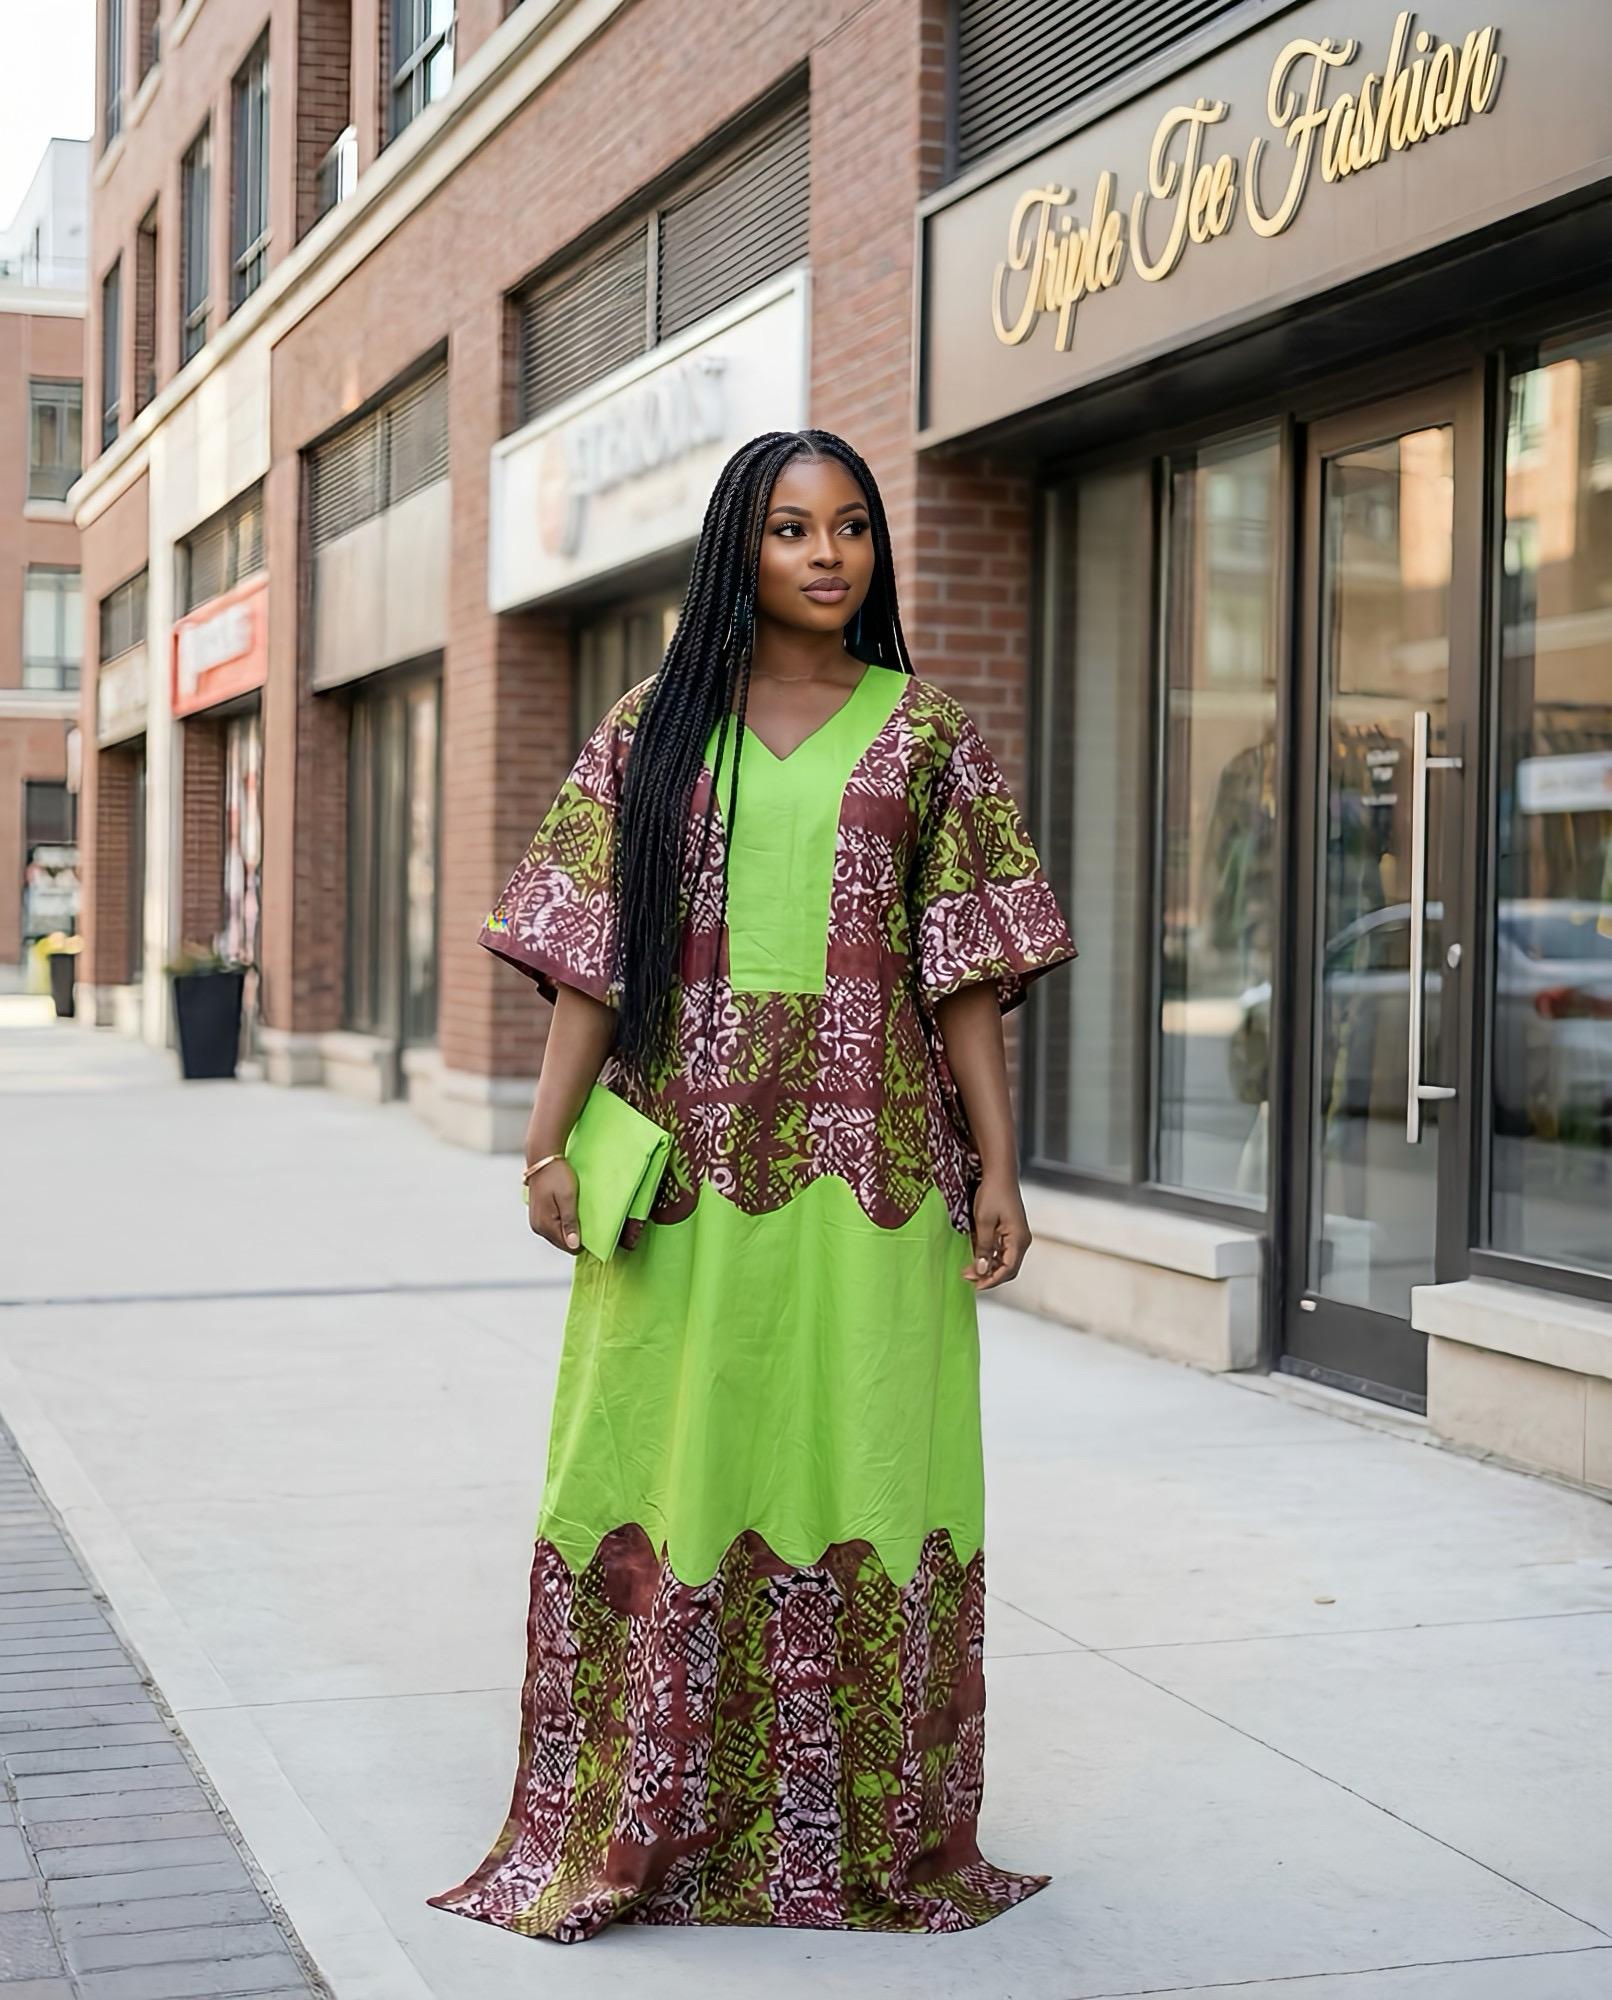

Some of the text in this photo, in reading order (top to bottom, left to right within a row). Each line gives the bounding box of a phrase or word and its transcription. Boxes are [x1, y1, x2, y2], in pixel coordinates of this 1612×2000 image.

[992, 11, 1503, 352] Triple Tee Fashion
